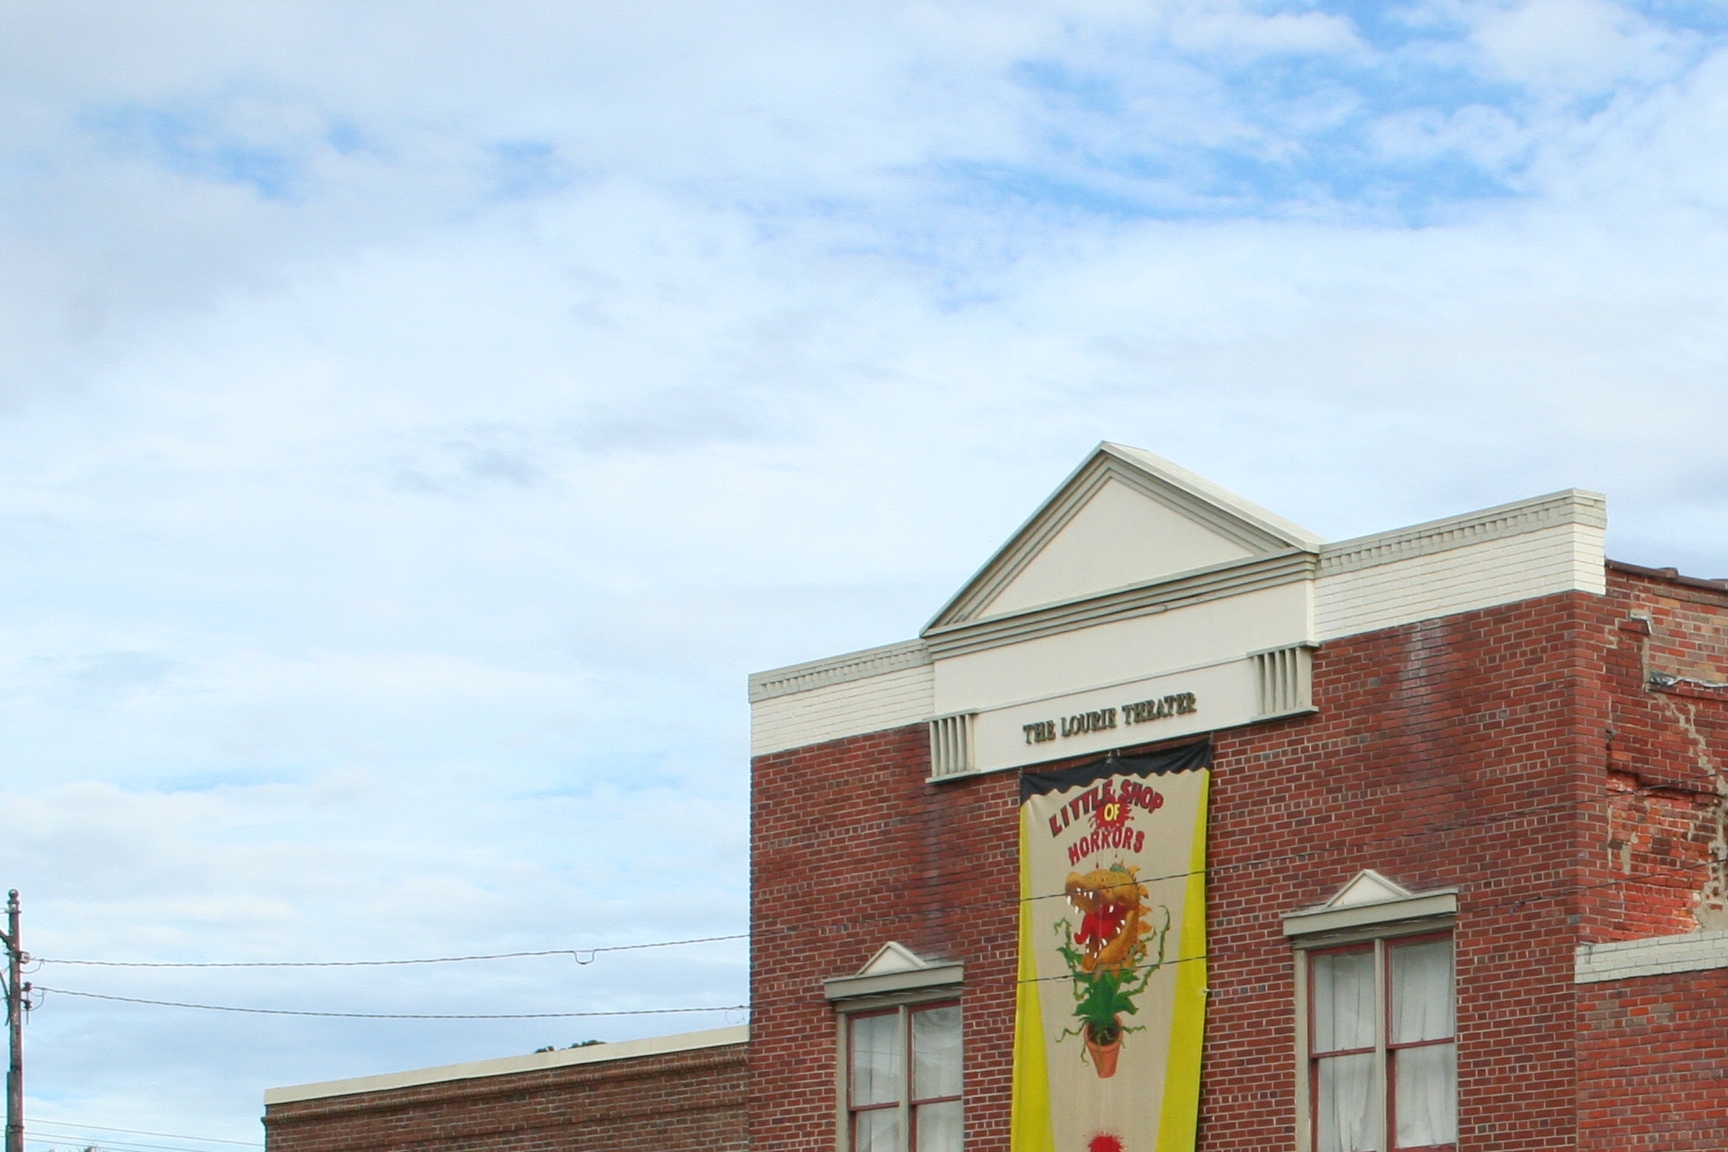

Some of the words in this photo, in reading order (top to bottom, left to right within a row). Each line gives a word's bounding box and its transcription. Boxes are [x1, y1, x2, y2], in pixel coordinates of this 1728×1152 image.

[1022, 719, 1056, 744] THE
[1061, 708, 1117, 737] LOURIE
[1121, 692, 1197, 725] THEATER
[1049, 779, 1116, 838] LITTLE
[1118, 779, 1164, 814] SHOP
[1103, 803, 1120, 821] OF
[1067, 826, 1145, 867] HORRORS
